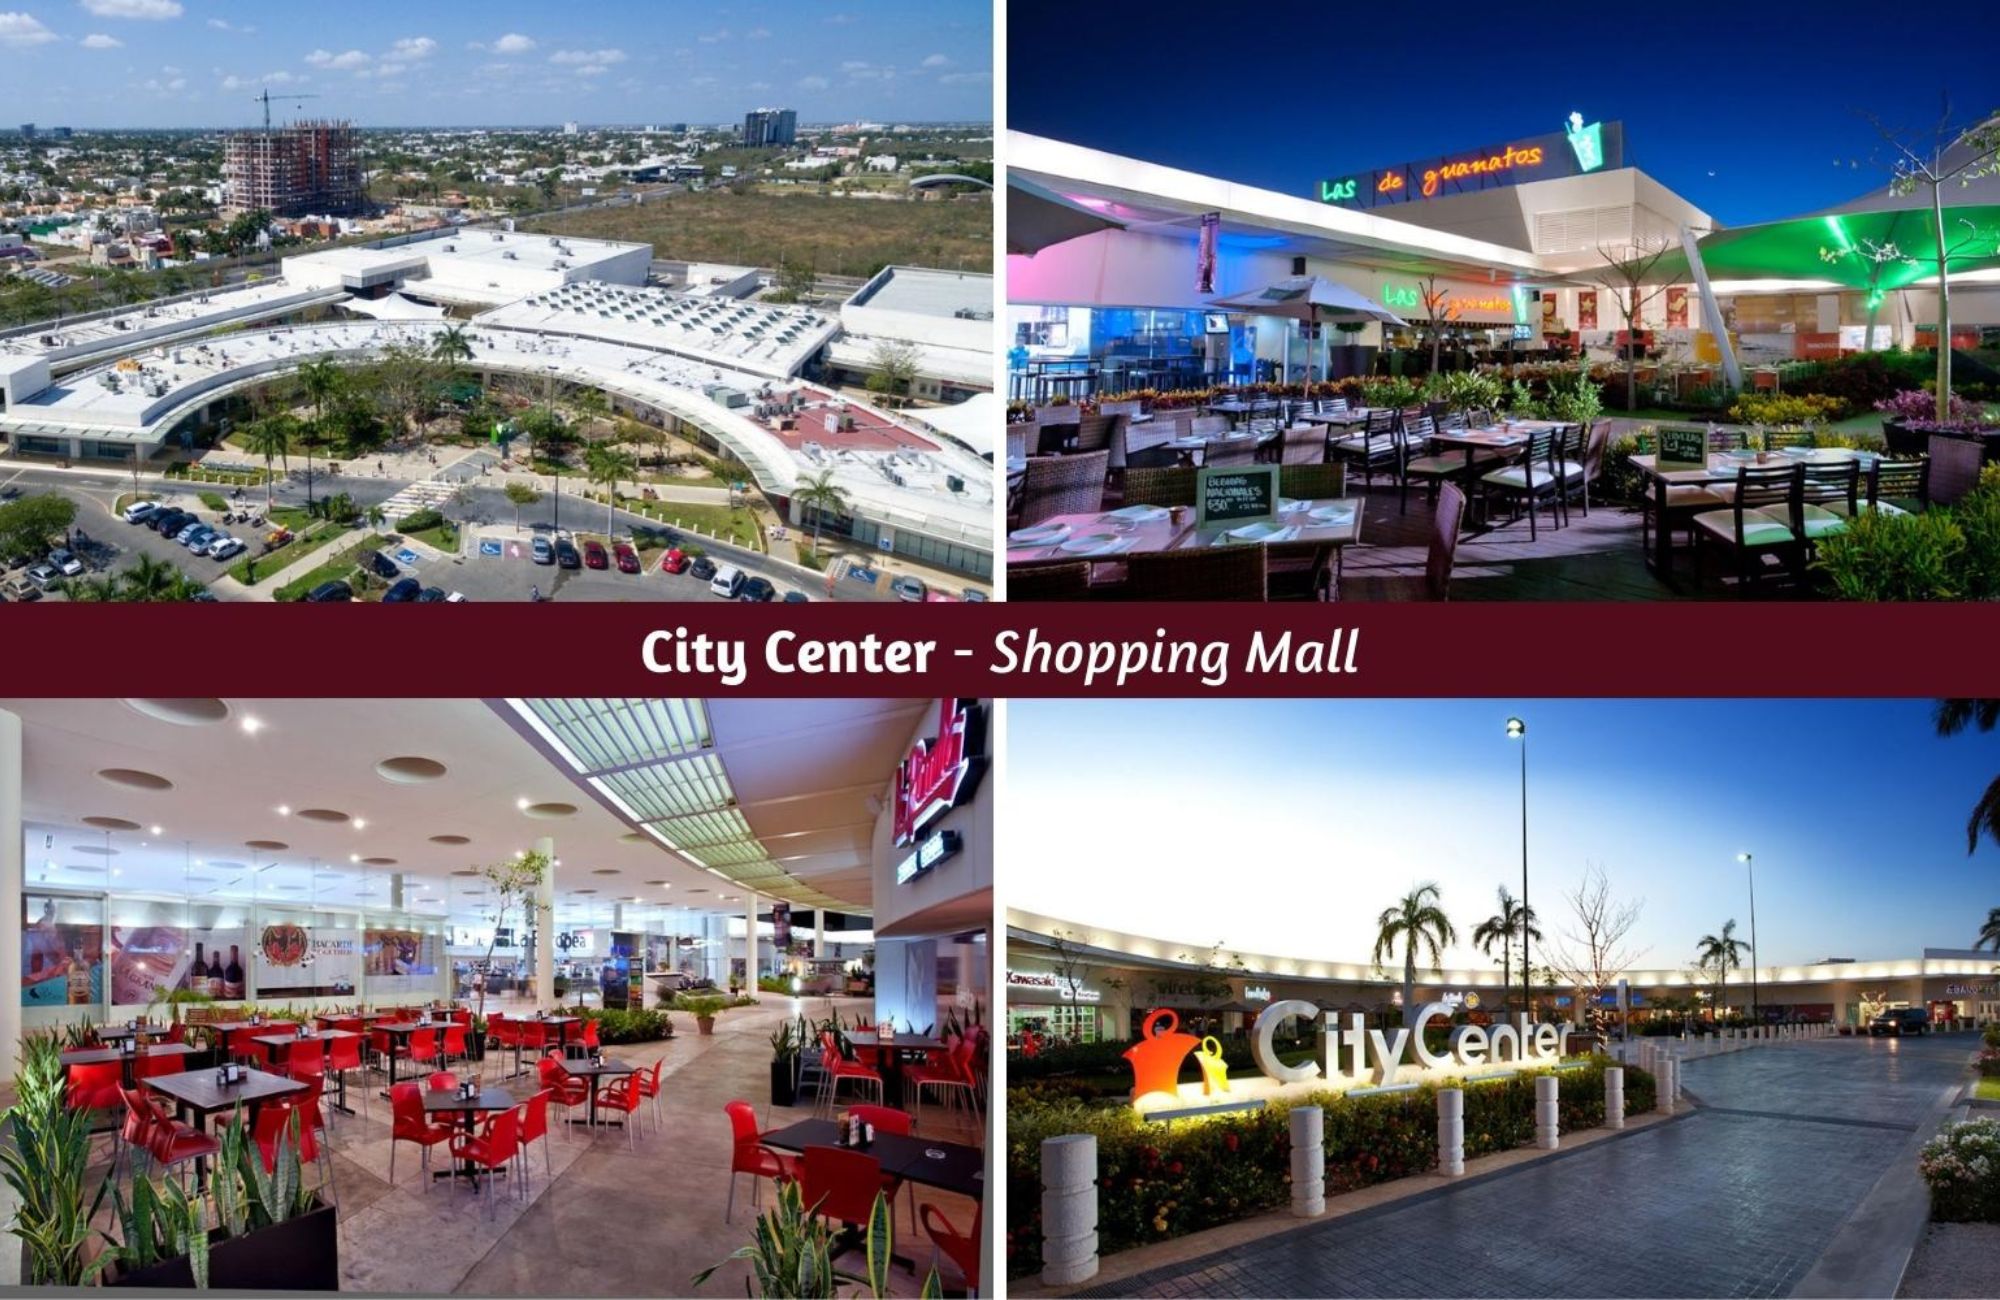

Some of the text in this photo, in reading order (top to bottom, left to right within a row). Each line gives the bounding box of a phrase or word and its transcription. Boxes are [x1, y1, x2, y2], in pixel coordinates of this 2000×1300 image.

[1322, 147, 1542, 200] Las de guanatos
[1384, 284, 1418, 307] Las
[1006, 971, 1055, 987] Kawasaki
